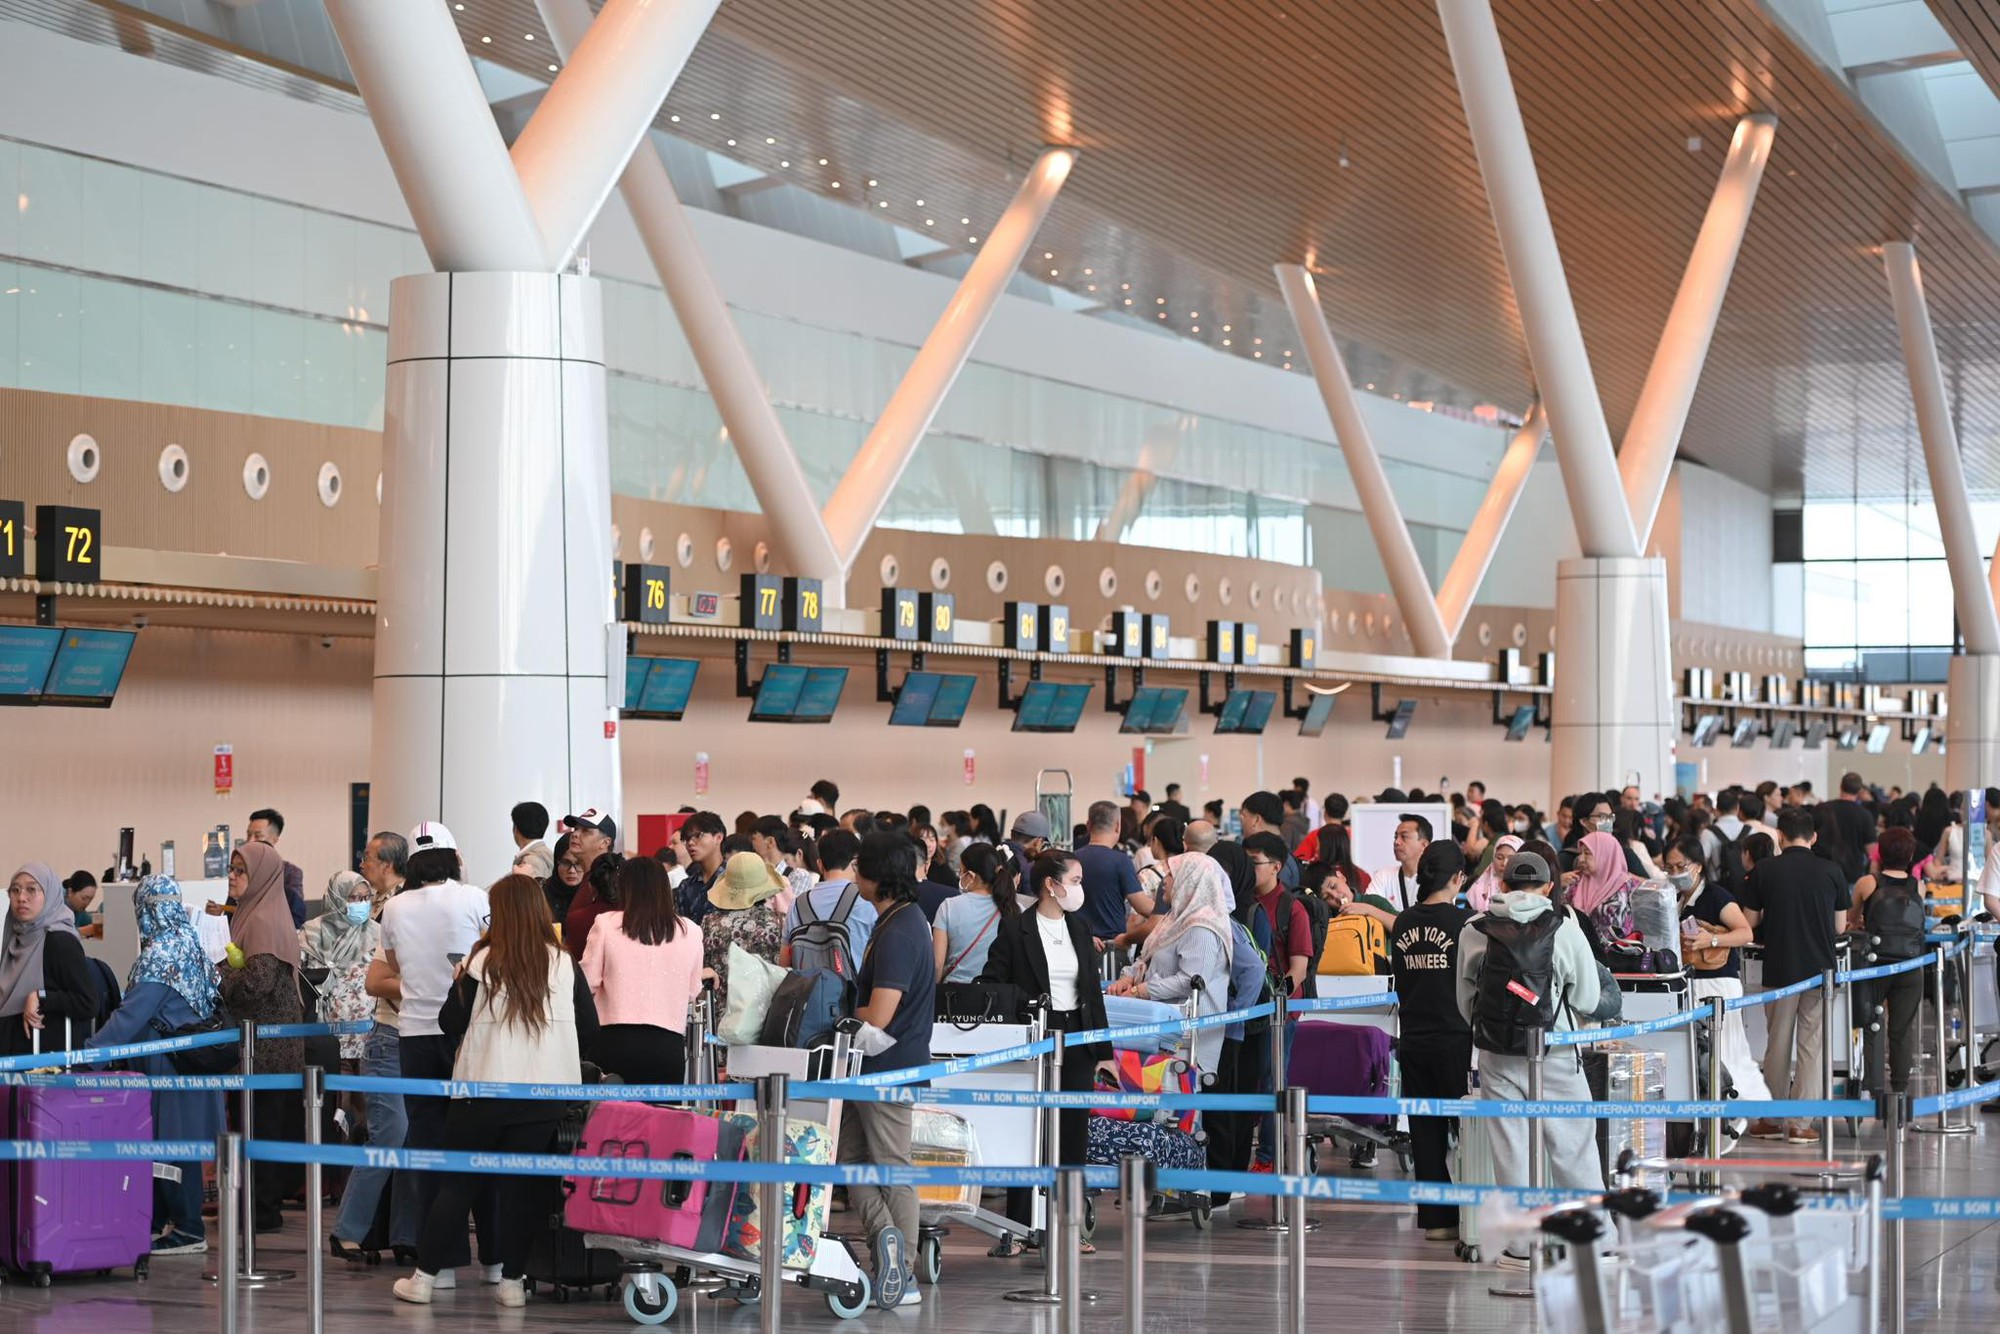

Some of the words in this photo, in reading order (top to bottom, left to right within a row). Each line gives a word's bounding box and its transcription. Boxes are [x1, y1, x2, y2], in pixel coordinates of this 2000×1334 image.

[0, 519, 14, 556] 1
[65, 526, 92, 563] 72
[646, 580, 664, 609] 76
[760, 588, 777, 616] 77
[802, 591, 818, 619] 78
[899, 601, 914, 627] 79
[935, 605, 950, 631] 80
[1396, 927, 1419, 952] NEW
[1424, 926, 1454, 952] YORK
[64, 1052, 84, 1065] TIA
[0, 1073, 26, 1085] IA
[440, 1082, 470, 1097] TIA
[586, 1085, 619, 1098] KHÔNG
[875, 1086, 915, 1102] TIA
[971, 1092, 991, 1103] TAN
[994, 1092, 1014, 1103] SON
[1016, 1093, 1041, 1104] NHAT
[1044, 1093, 1118, 1105] INTERNATIONAL
[1121, 1095, 1160, 1106] AIRPORT
[1397, 1099, 1432, 1114] TIA
[1501, 1103, 1524, 1114] TAN
[1526, 1103, 1550, 1114] SON
[1553, 1103, 1583, 1115] NHAT
[1586, 1104, 1673, 1115] INTERNATIONAL
[1676, 1104, 1727, 1115] AIRPORT
[12, 1141, 47, 1158] TIA
[114, 1143, 138, 1156] TAN
[140, 1143, 166, 1156] SON
[167, 1144, 198, 1156] NHAT
[364, 1148, 400, 1167] TIA
[841, 1166, 880, 1184] TIA
[957, 1170, 982, 1182] TAN
[984, 1170, 1012, 1182] SON
[1014, 1170, 1049, 1182] NHAT
[1280, 1176, 1333, 1197] TIA
[1932, 1202, 1958, 1214] TAN
[1964, 1202, 1990, 1214] SON
